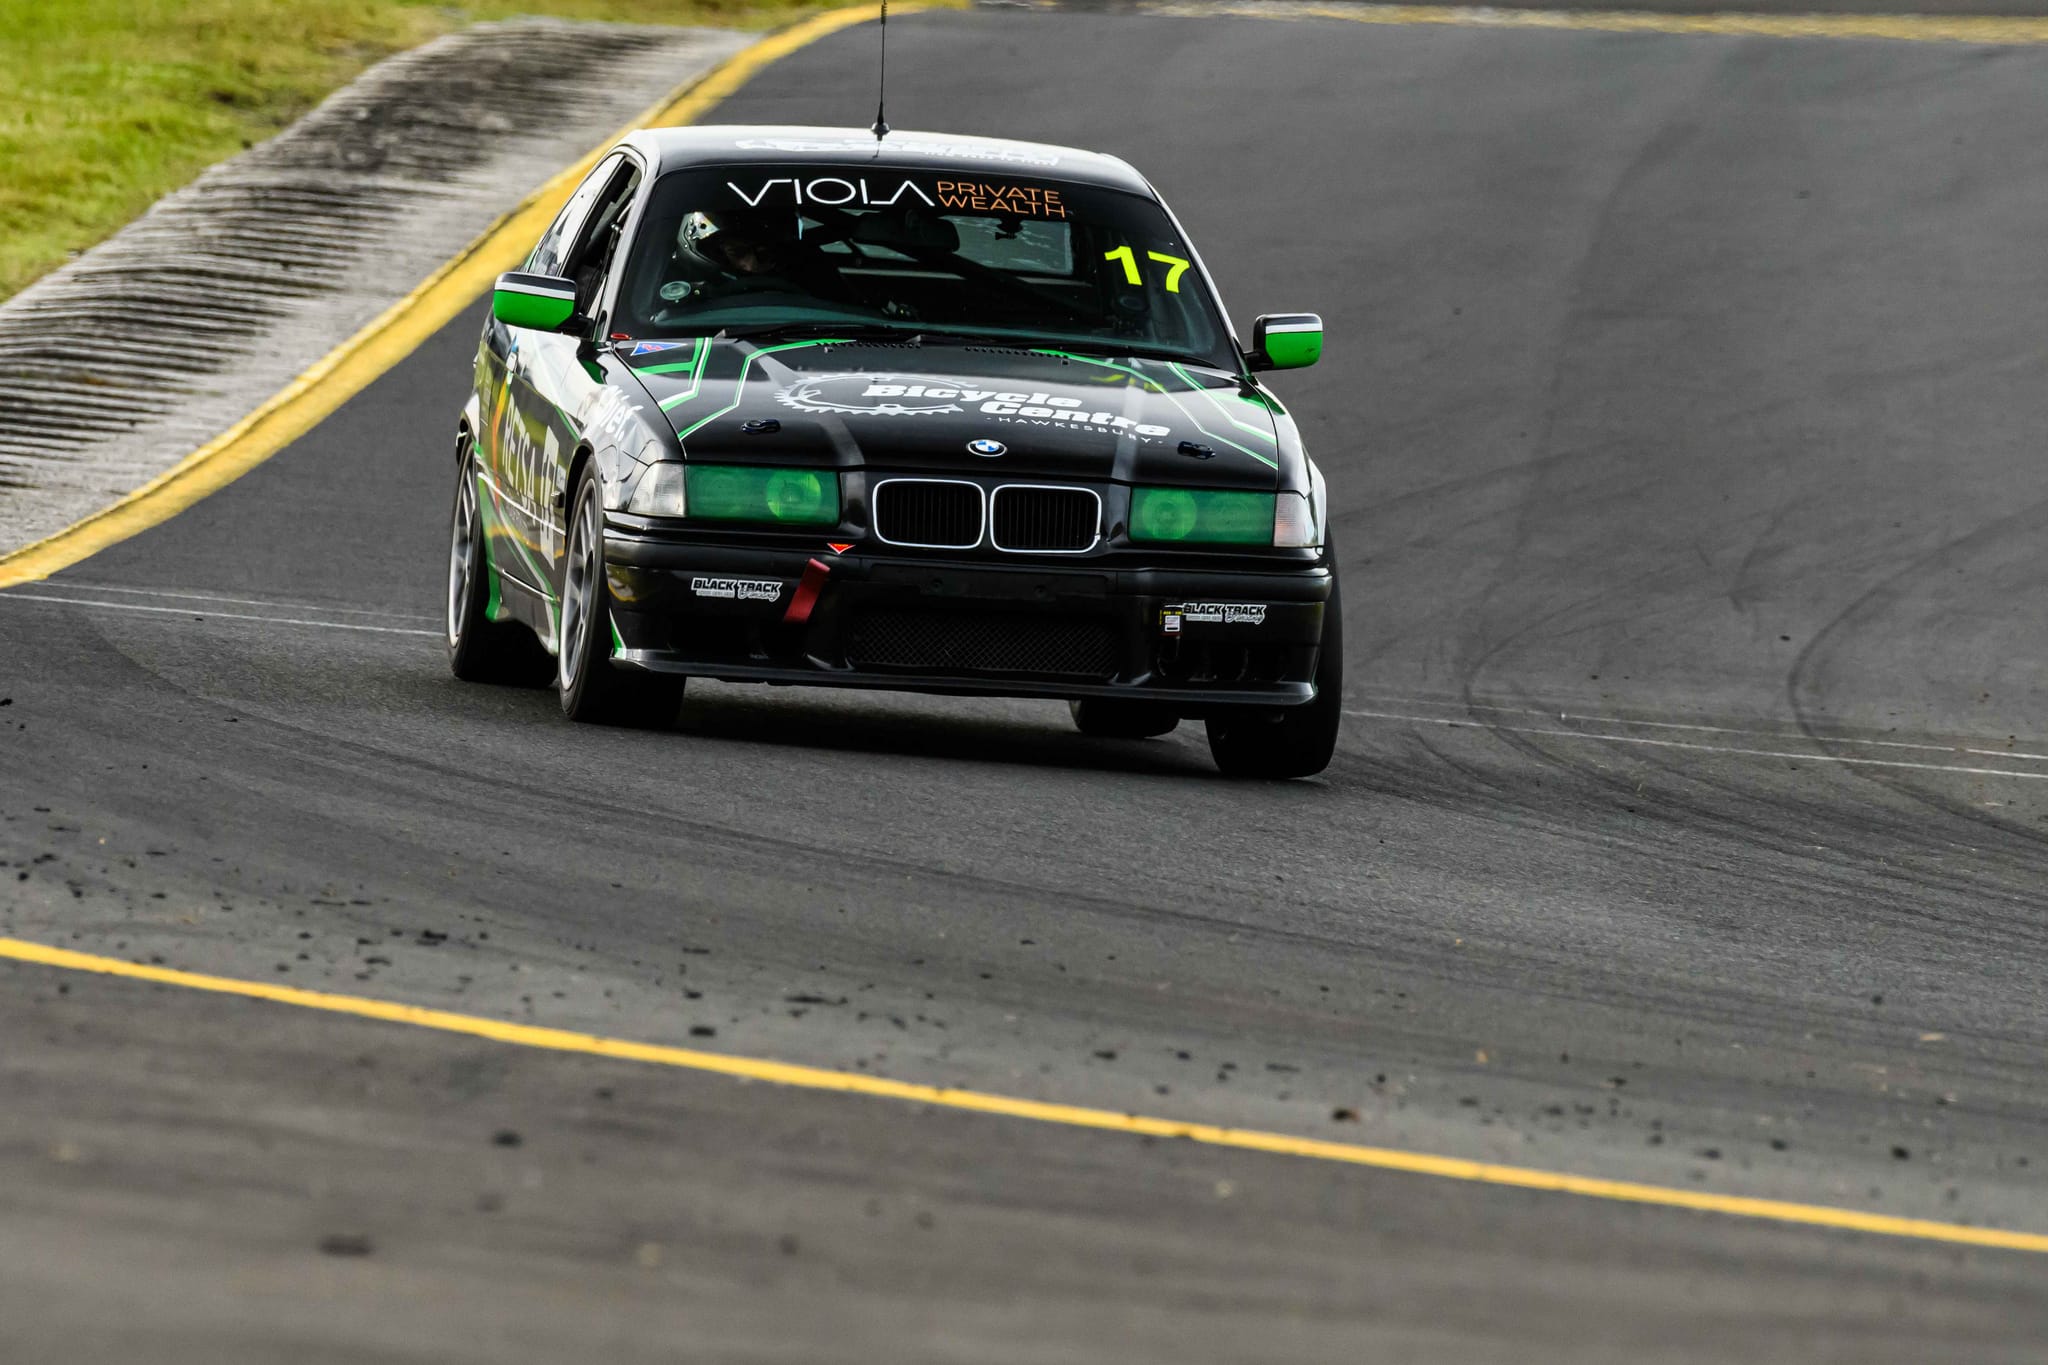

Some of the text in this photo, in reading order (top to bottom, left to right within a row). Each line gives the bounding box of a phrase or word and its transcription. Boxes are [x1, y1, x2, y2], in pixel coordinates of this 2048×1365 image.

[727, 177, 936, 207] VIOLA
[937, 180, 1062, 204] PRIVATE
[938, 193, 1066, 218] WEALTH
[1103, 245, 1191, 294] 17
[861, 384, 1084, 409] Bicycle
[979, 400, 1171, 437] Centre
[692, 578, 735, 591] BLACK
[738, 580, 782, 593] TRACK
[1183, 603, 1223, 615] BLACK
[1225, 605, 1266, 616] TRACK
